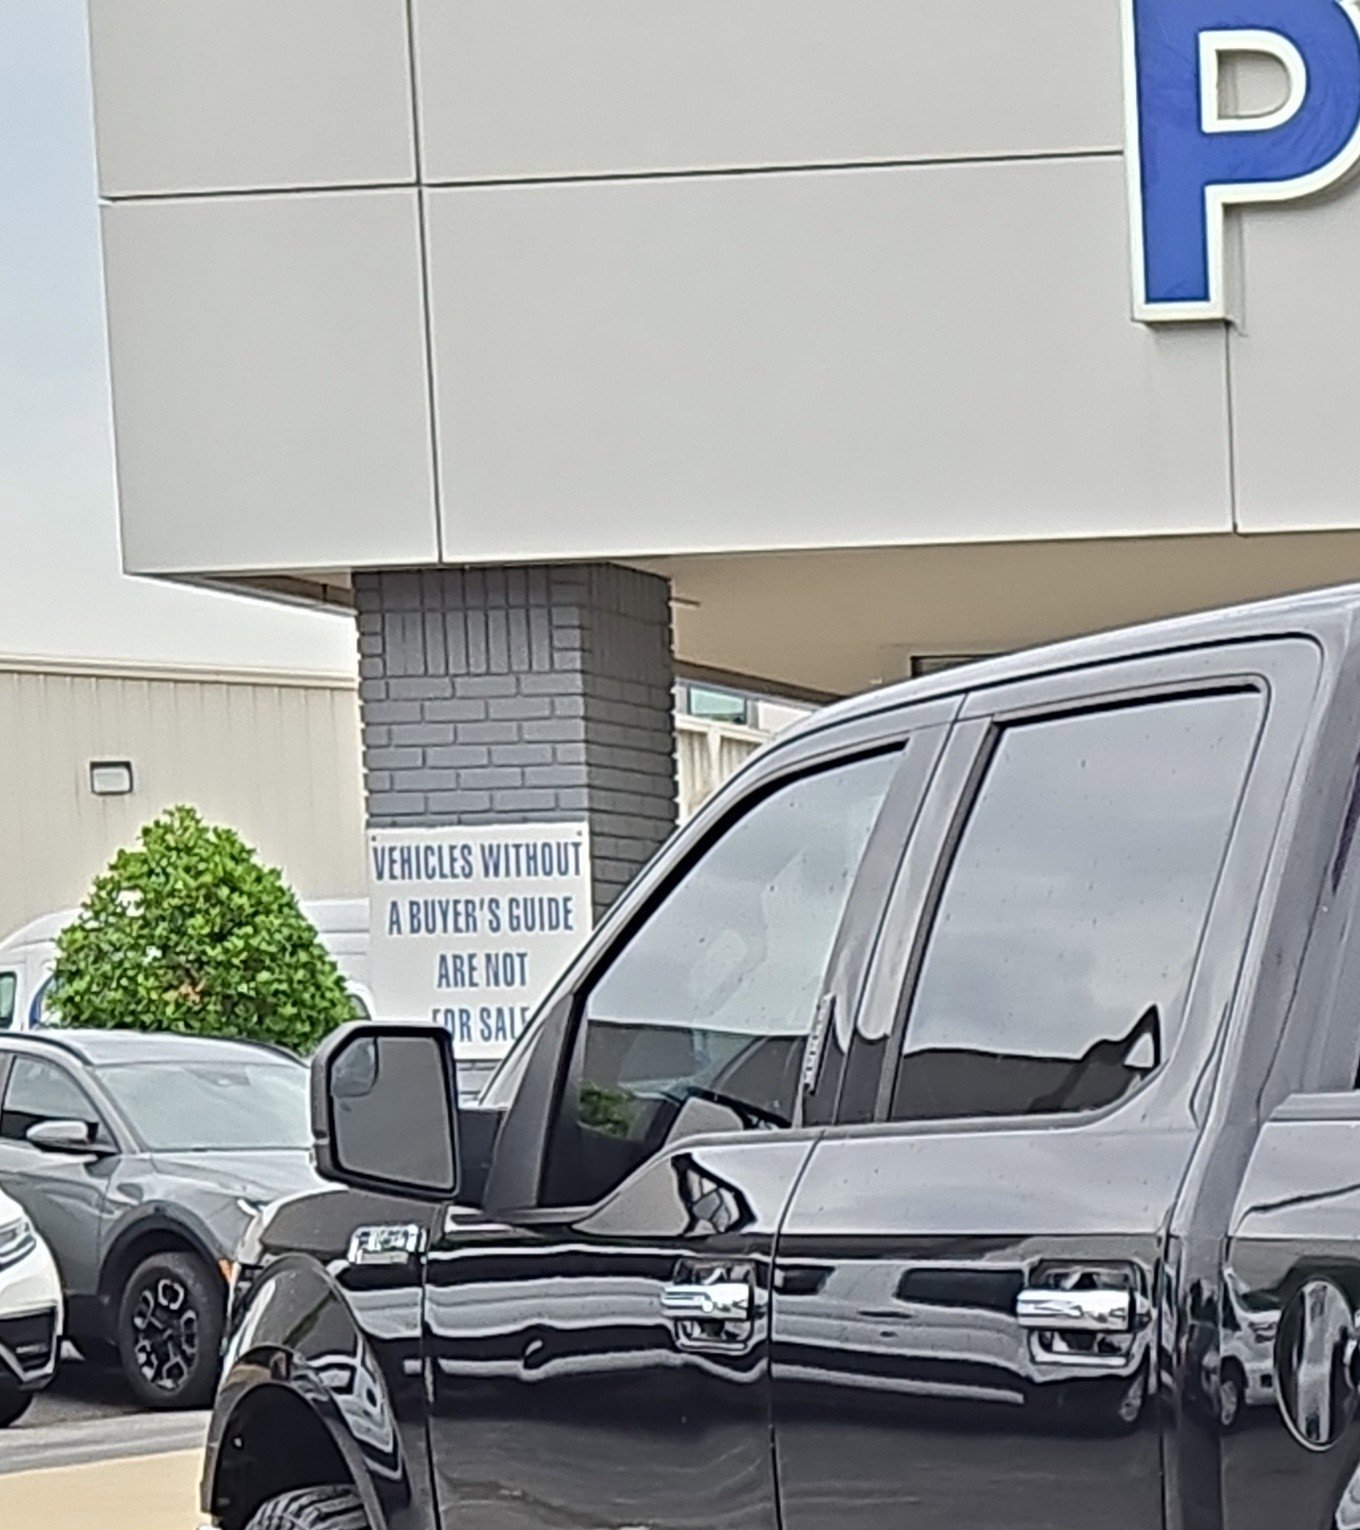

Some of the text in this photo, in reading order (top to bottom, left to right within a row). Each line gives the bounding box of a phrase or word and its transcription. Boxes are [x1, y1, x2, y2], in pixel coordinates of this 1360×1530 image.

[372, 841, 583, 881] VEHICLES WITHOUT
[388, 896, 574, 935] A BUYER'S GUIDE
[437, 952, 528, 988] ARE NOT
